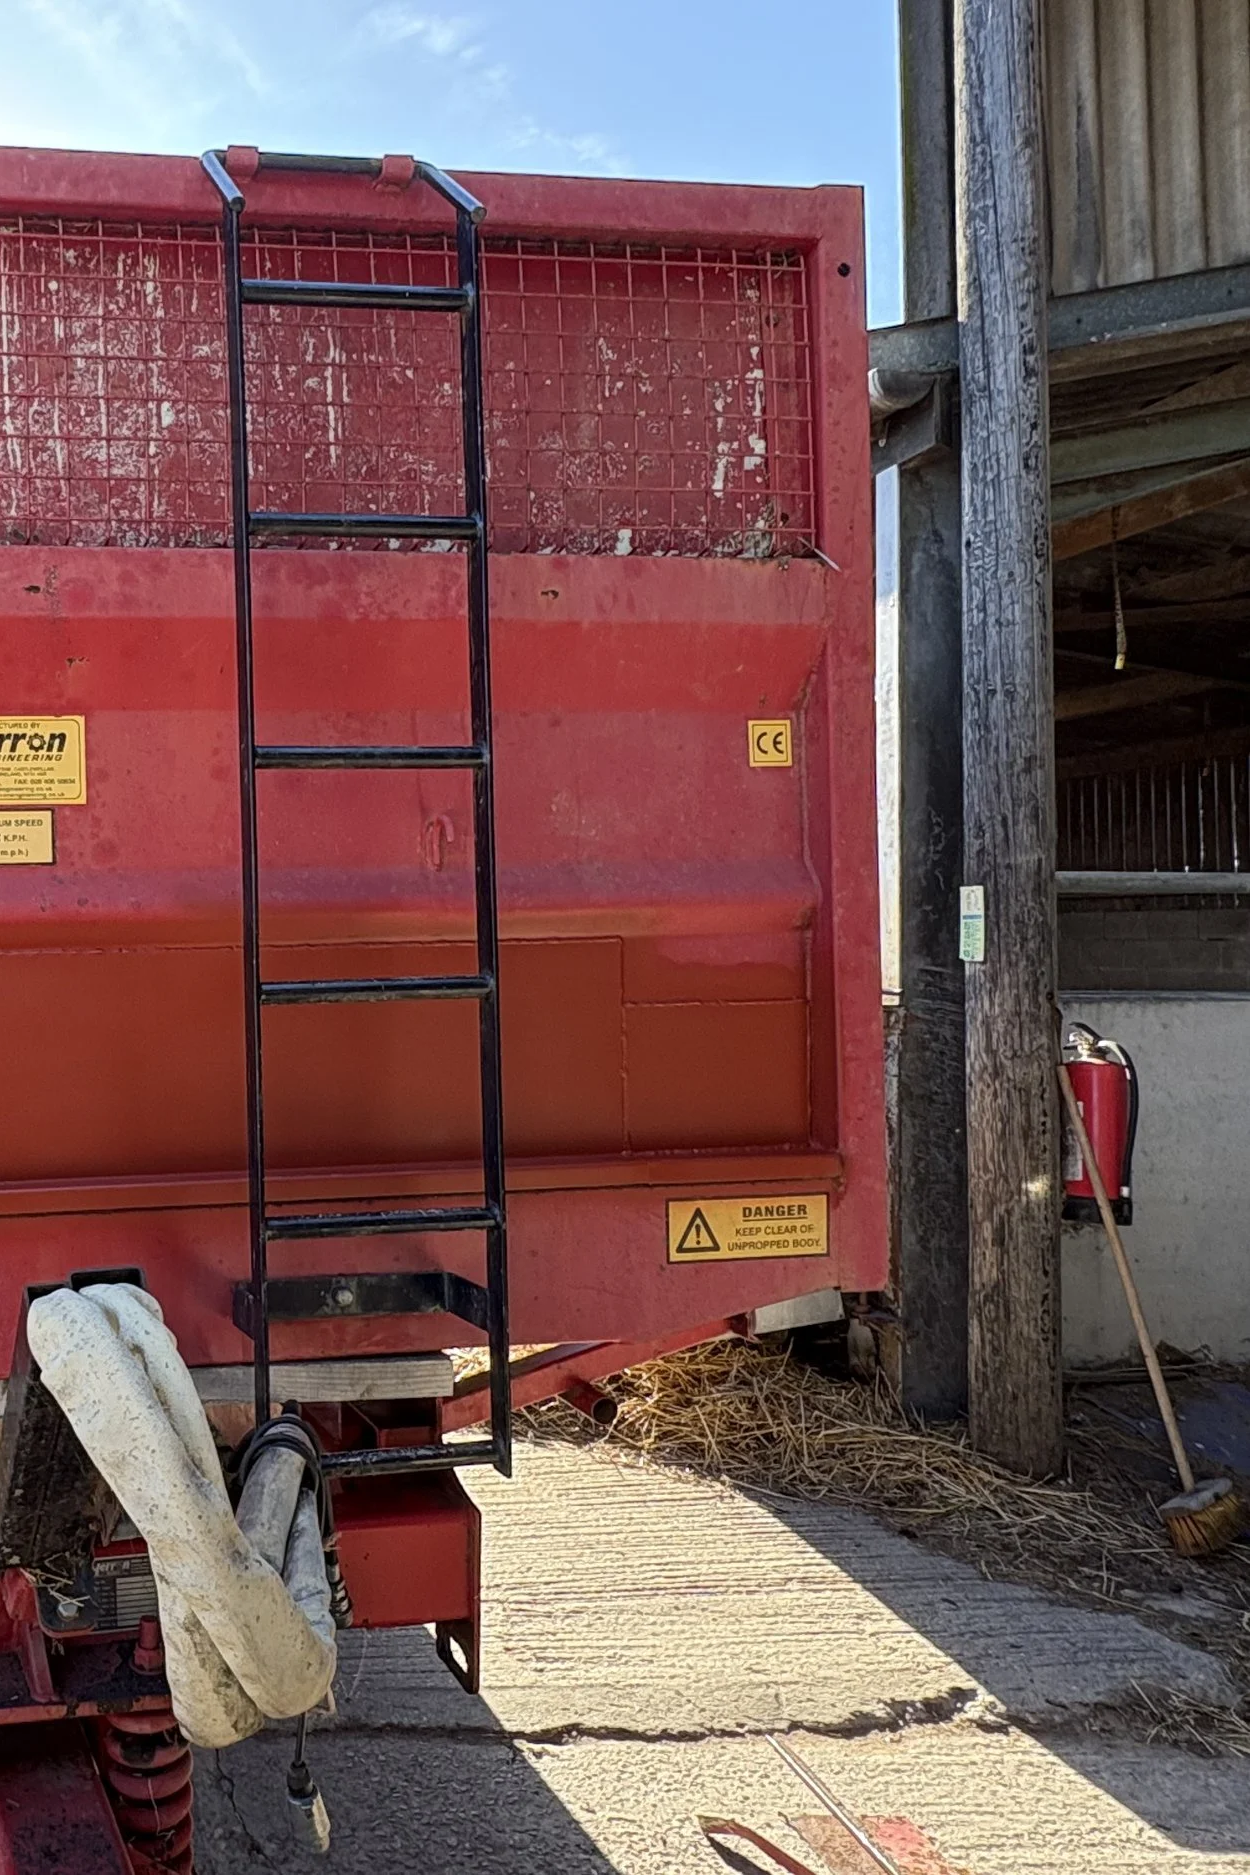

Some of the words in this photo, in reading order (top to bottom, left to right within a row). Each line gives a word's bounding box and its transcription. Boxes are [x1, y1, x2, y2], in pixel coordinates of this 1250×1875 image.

[13, 818, 43, 827] SPEED
[742, 1204, 808, 1218] DANGER
[735, 1226, 762, 1237] KEEP
[764, 1225, 797, 1236] CLEAR
[800, 1224, 814, 1234] OF
[727, 1239, 790, 1252] UNPROPPED
